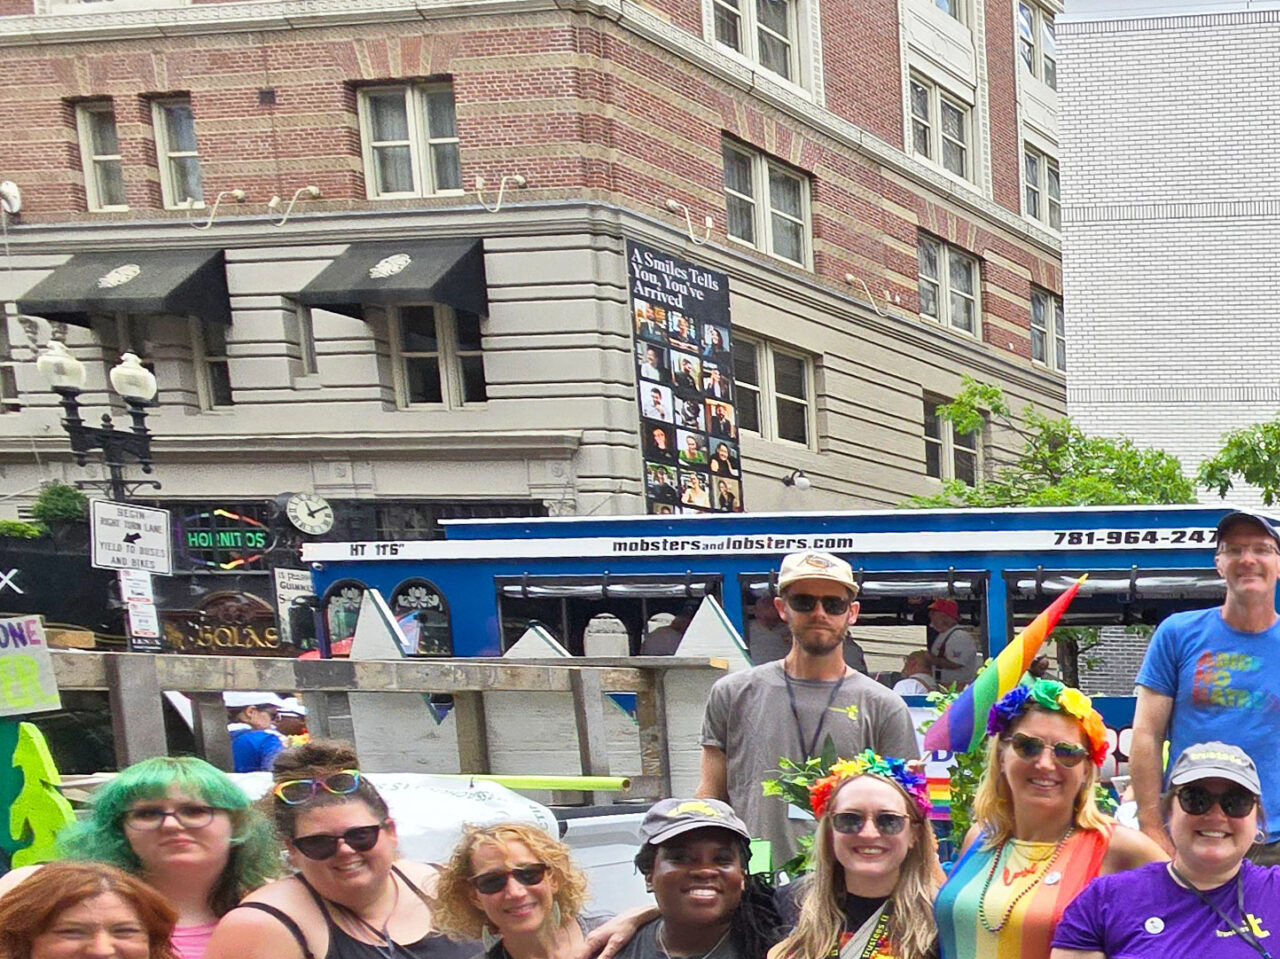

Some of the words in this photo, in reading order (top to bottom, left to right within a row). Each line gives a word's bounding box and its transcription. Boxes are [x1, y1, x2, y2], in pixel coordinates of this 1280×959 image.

[631, 248, 643, 264] A
[644, 252, 688, 280] Smiles
[688, 268, 719, 291] Tells
[632, 262, 661, 291] You,
[662, 273, 704, 300] You've
[634, 280, 683, 308] Arrived
[117, 507, 145, 520] BEGIN
[100, 517, 119, 528] RIGHT
[124, 520, 141, 531] TURN
[144, 523, 162, 534] LANE
[187, 532, 265, 548] HORNITOS
[1053, 531, 1218, 546] 781-964-247
[99, 541, 122, 552] YIELD
[126, 543, 135, 553] TO
[140, 546, 165, 558] BUSES
[350, 543, 366, 556] HT
[111, 556, 127, 566] AND
[132, 557, 155, 569] BIKES
